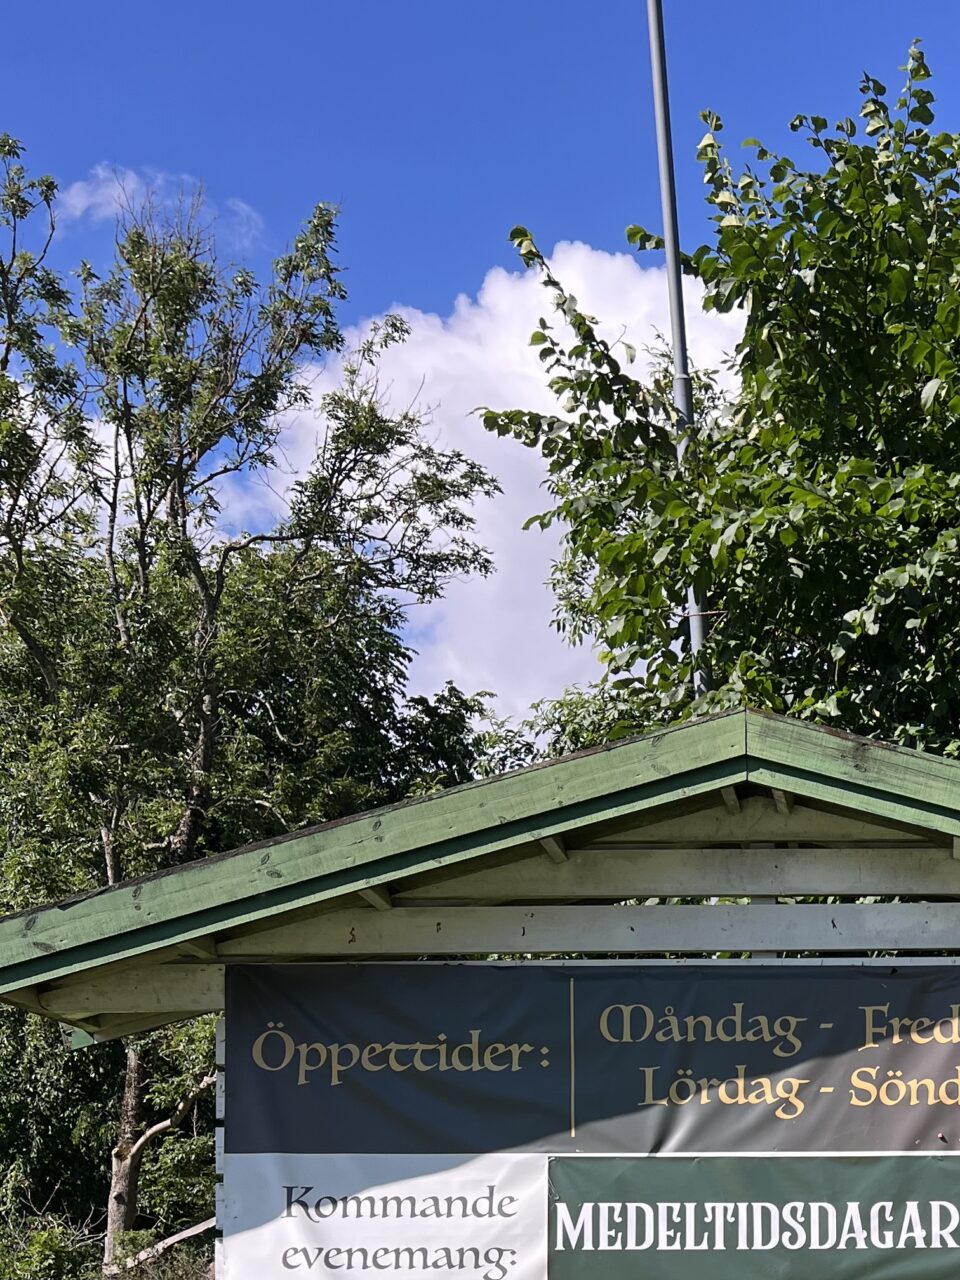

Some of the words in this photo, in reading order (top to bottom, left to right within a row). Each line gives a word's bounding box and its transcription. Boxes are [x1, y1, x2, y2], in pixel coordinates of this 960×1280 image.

[251, 1022, 551, 1086] Öppettider:
[599, 1002, 808, 1058] Måndag
[638, 1064, 810, 1120] Lördag
[282, 1185, 518, 1224] Kommande
